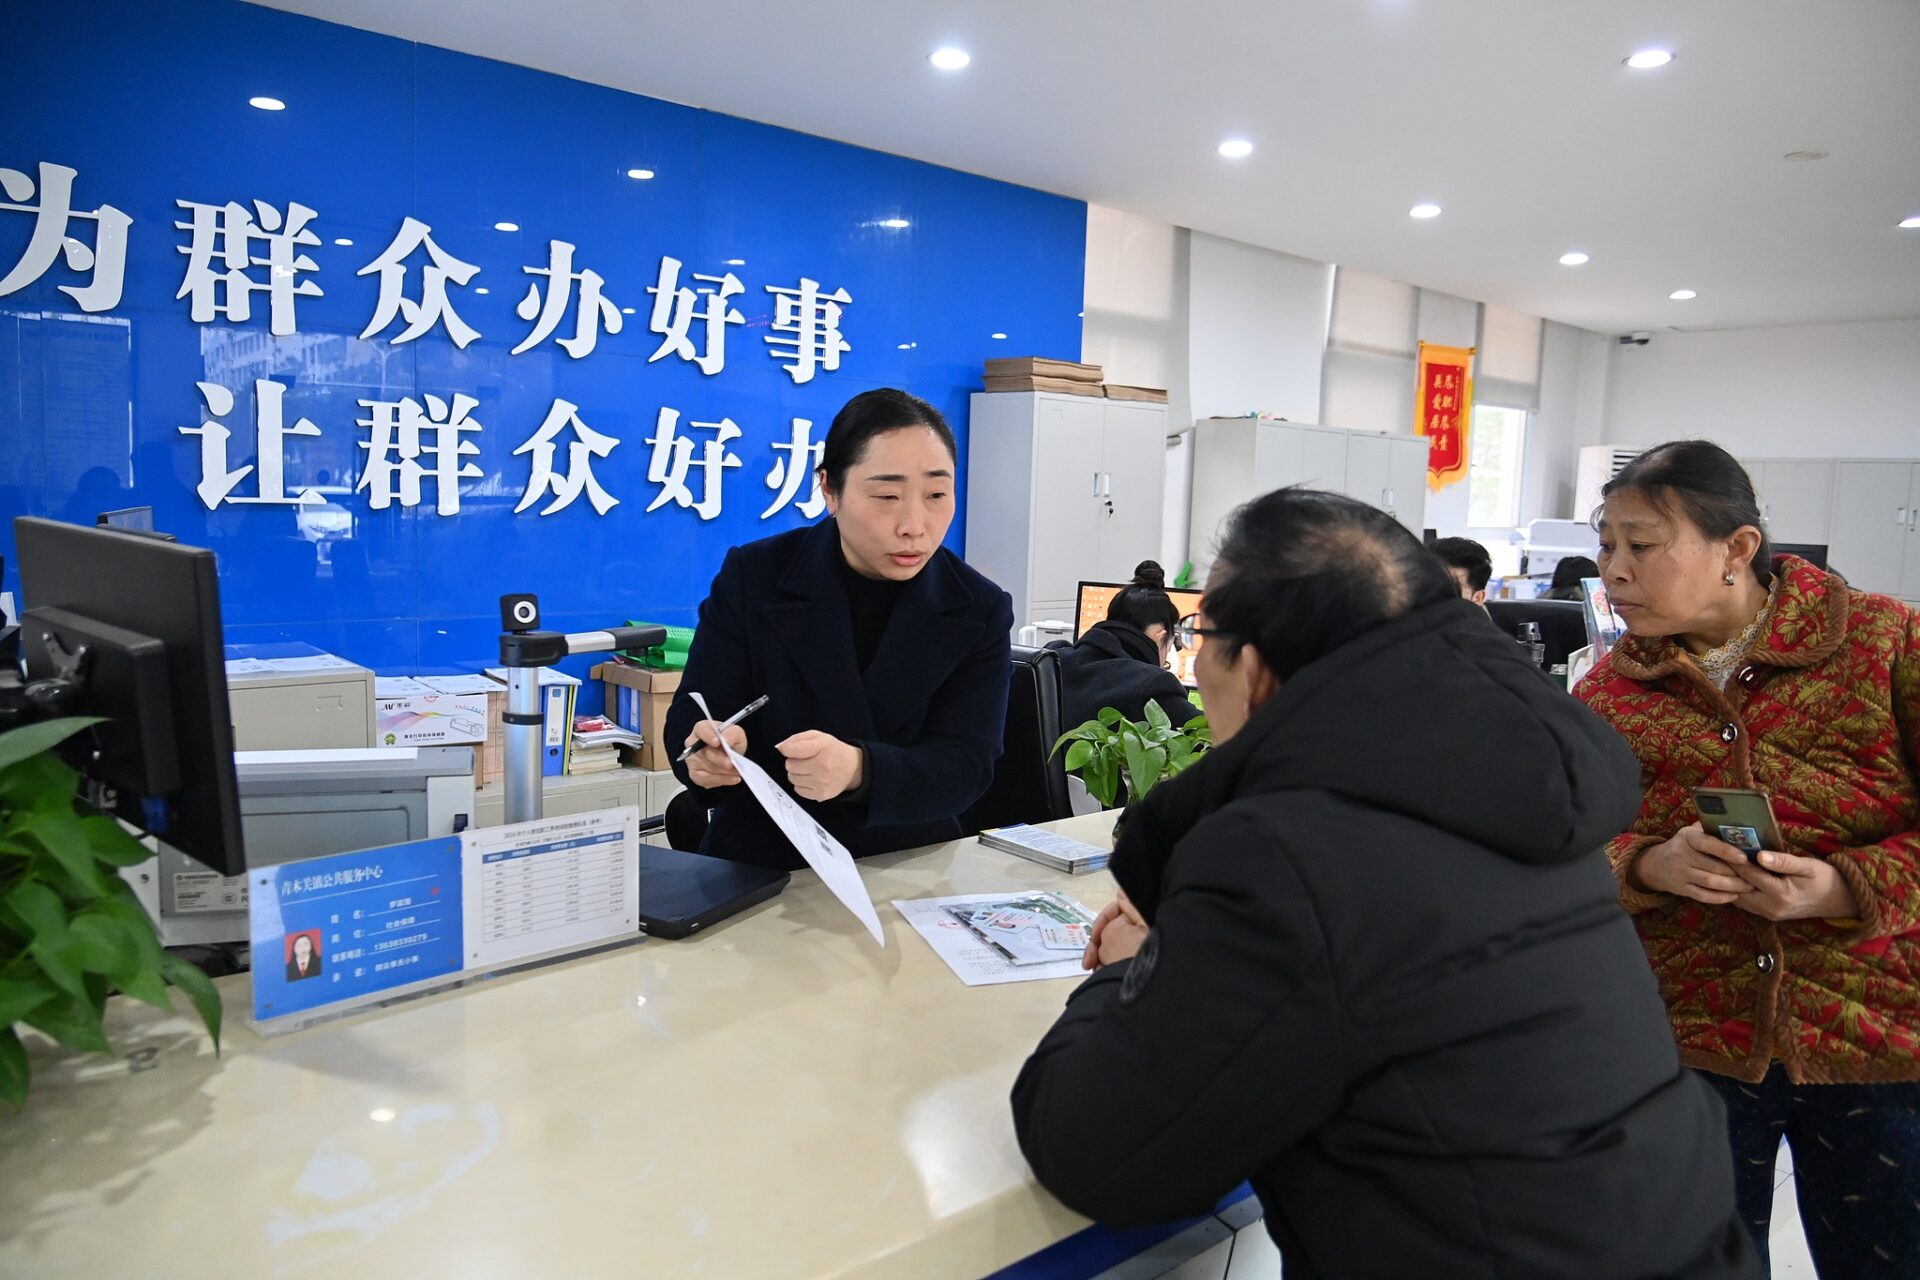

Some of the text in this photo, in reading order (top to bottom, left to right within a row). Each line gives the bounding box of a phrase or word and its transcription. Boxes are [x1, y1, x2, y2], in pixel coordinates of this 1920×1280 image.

[0, 161, 853, 385] 为群众办好事
[282, 865, 384, 897] 青木关镇公共服务中心
